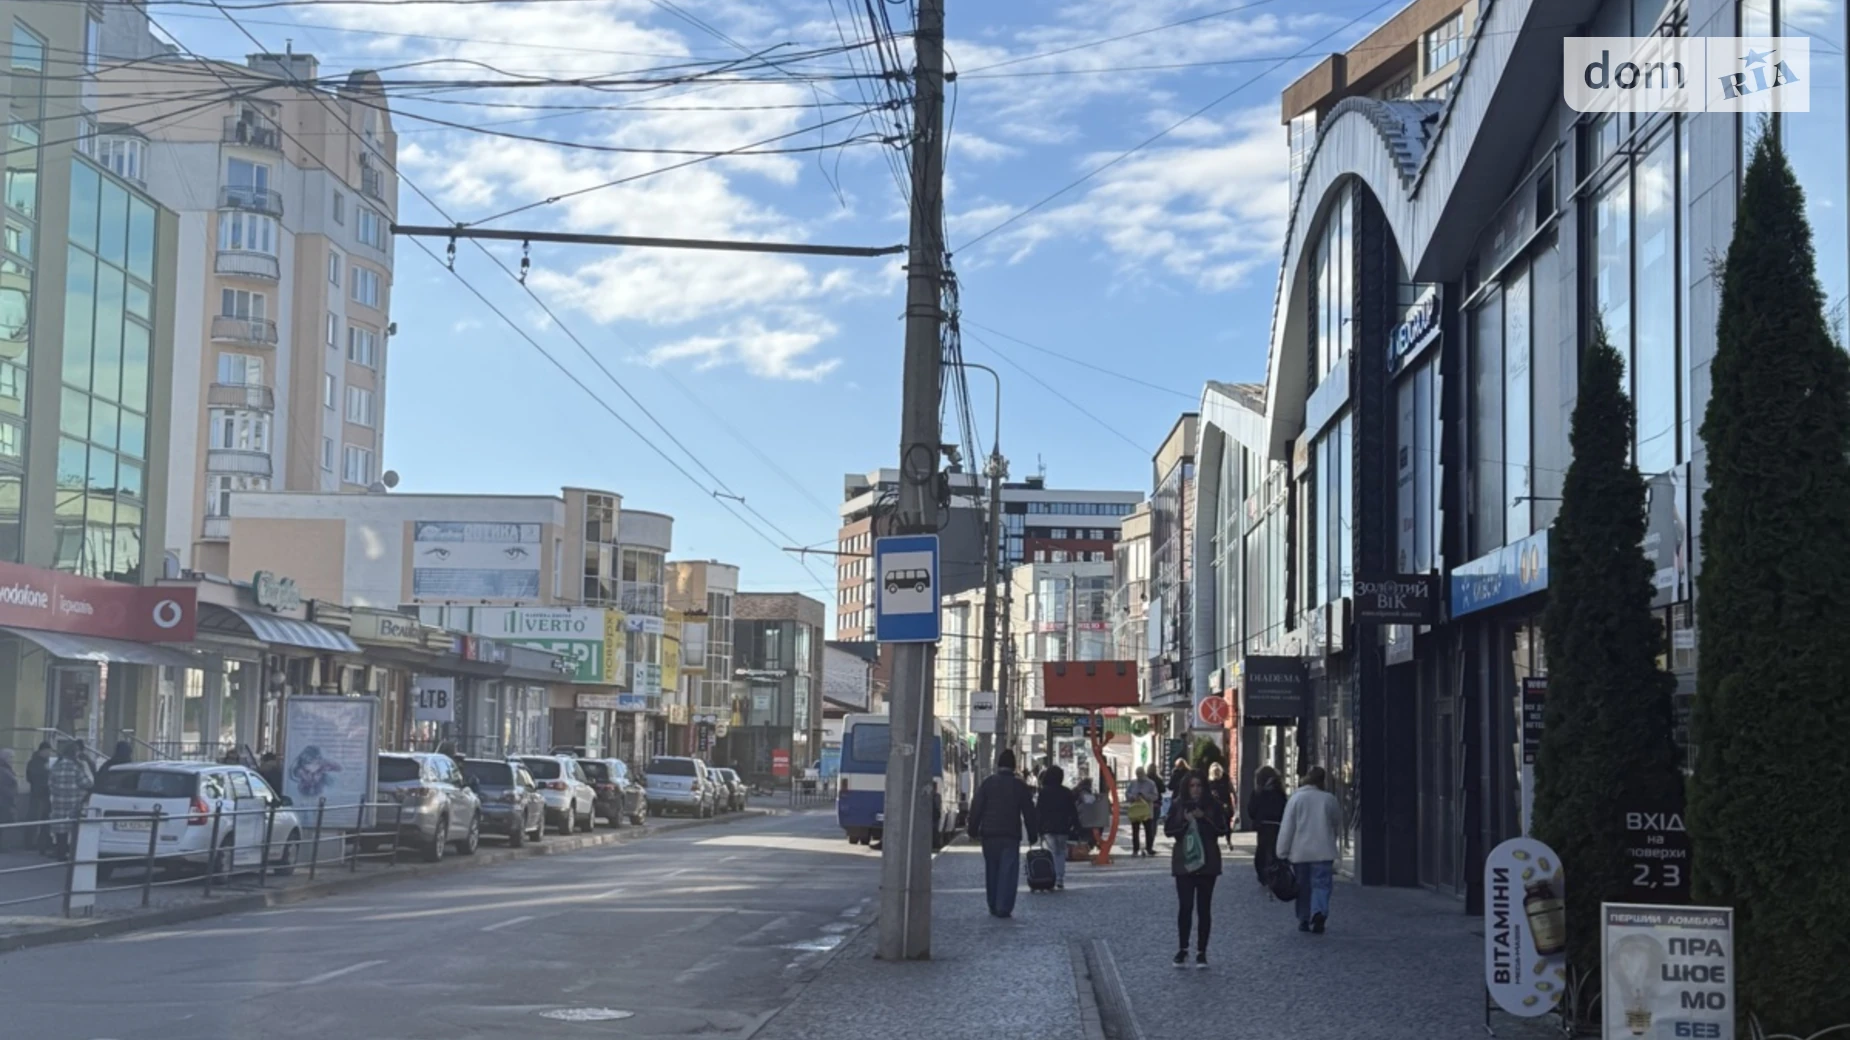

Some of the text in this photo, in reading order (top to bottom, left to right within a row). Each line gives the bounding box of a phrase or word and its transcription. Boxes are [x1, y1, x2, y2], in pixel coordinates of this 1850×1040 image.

[0, 583, 49, 608] vodafone
[525, 619, 585, 632] VERTO
[1249, 673, 1300, 684] DIADEMA
[420, 690, 447, 708] LTB
[1626, 812, 1686, 831] ВХІД
[1647, 835, 1665, 844] на
[1493, 868, 1511, 984] ВІТАМІНИ
[1667, 915, 1726, 926] ЛОМБАРД
[1668, 937, 1725, 957] ПРА
[1661, 963, 1726, 983] ЦЮЄ
[1681, 990, 1726, 1010] МО
[1675, 1021, 1720, 1039] БЕЗ
